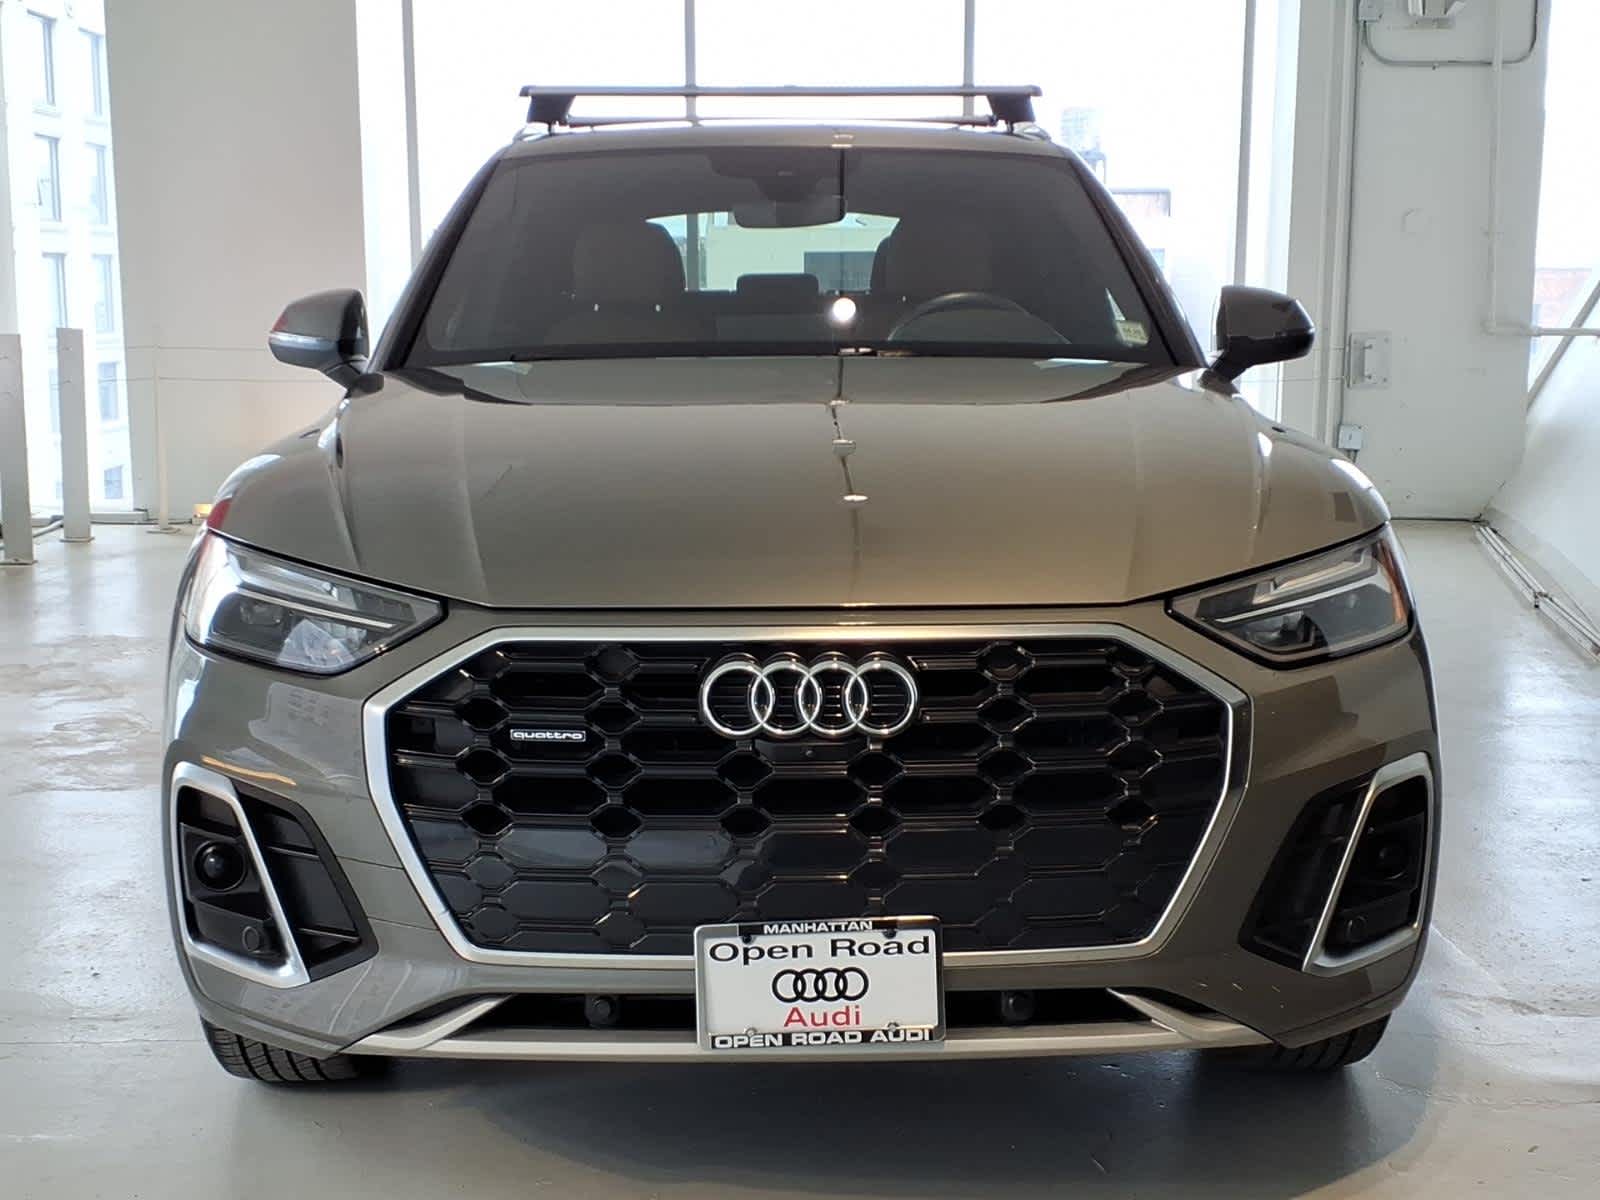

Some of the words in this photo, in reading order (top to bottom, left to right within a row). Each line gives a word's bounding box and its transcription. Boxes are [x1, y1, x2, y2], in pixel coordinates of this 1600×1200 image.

[513, 731, 583, 740] quattro
[763, 920, 873, 935] MANHATTAN
[709, 941, 813, 966] Open
[830, 936, 930, 957] Road
[783, 1005, 861, 1027] Audi
[714, 1032, 783, 1049] OPEN
[791, 1030, 863, 1046] ROAD
[870, 1028, 930, 1044] AUDI
